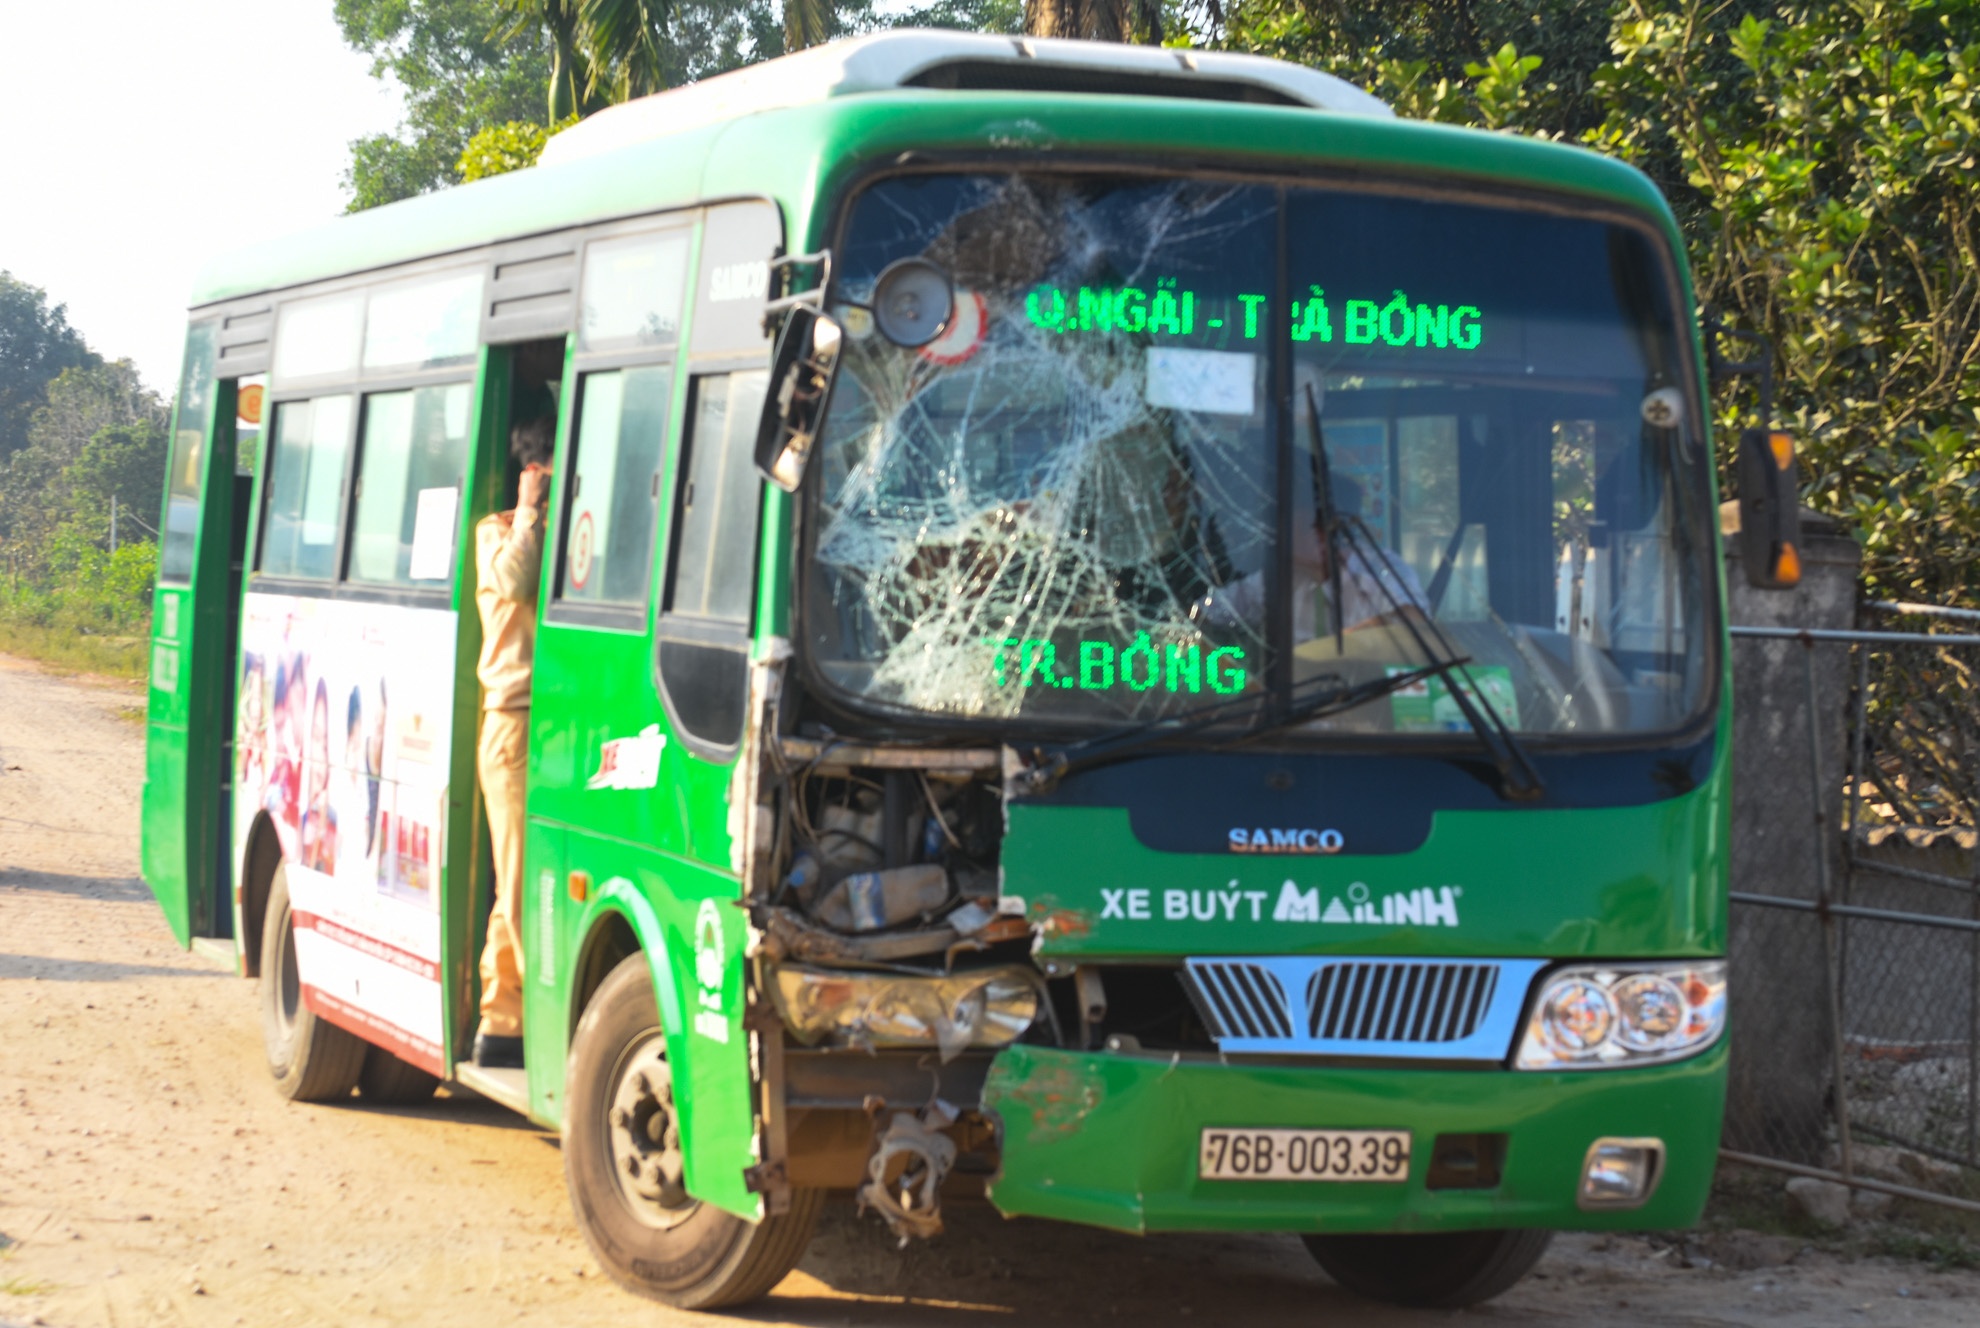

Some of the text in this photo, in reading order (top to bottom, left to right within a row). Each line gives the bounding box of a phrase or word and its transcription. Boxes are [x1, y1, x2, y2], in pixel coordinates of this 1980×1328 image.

[1344, 289, 1482, 350] BỒNG
[1228, 828, 1344, 853] SAMCO
[1100, 888, 1152, 920] XE
[1163, 880, 1267, 921] BUÝT
